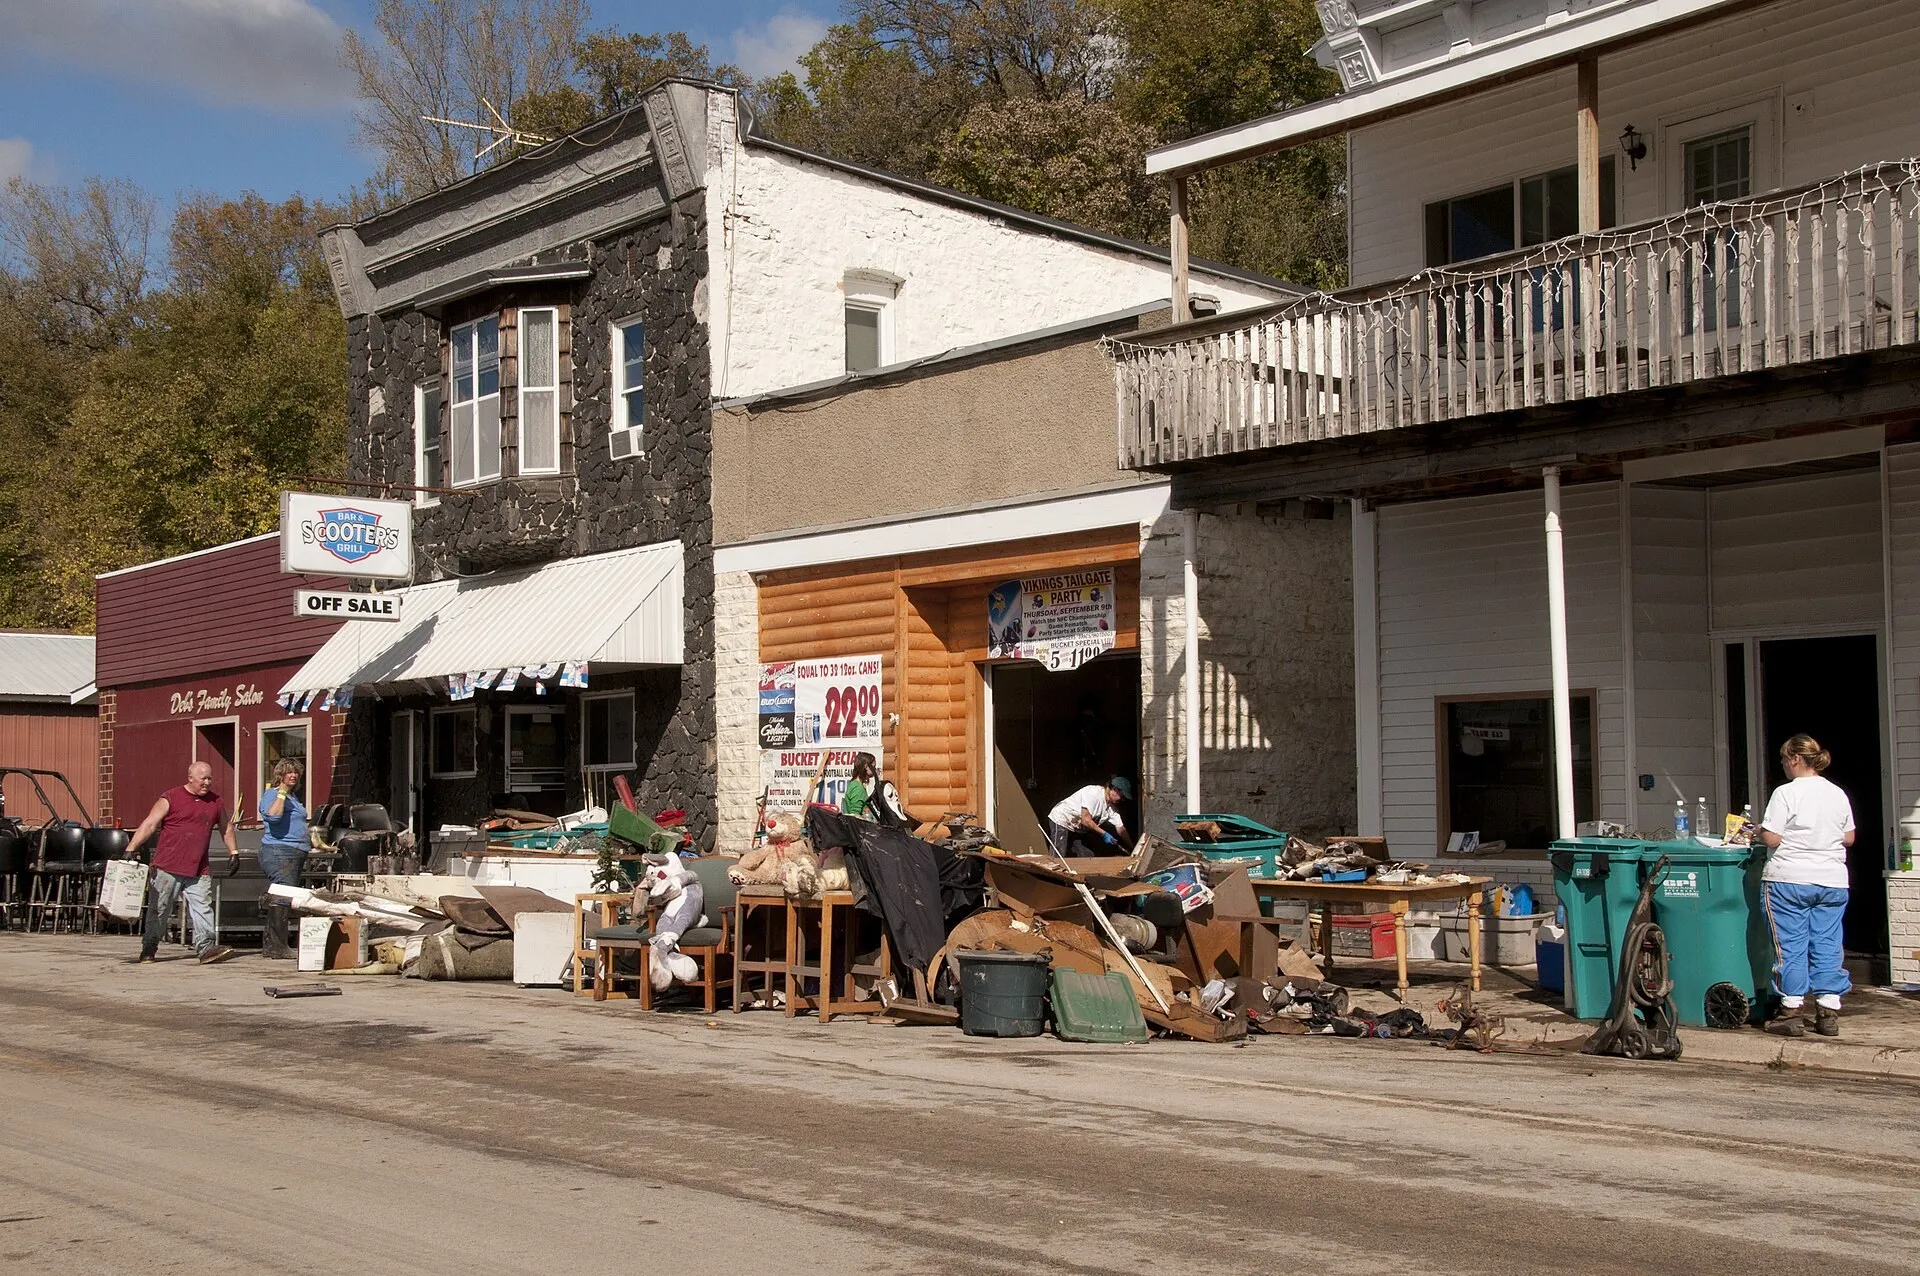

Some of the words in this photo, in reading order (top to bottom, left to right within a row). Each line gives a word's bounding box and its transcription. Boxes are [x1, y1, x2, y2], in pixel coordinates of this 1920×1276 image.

[337, 512, 356, 521] BAR
[301, 520, 399, 550] SCOOTER'S
[336, 543, 365, 553] GRILL
[1022, 576, 1063, 592] VIKINGS
[1064, 570, 1112, 586] TAILGATE
[1050, 589, 1082, 604] PARTY
[307, 596, 342, 612] OFF
[347, 598, 392, 614] SALE
[1023, 608, 1059, 618] THURSDAY,
[1060, 604, 1100, 615] SEPTEMBER
[1029, 617, 1046, 625] Watch
[1068, 613, 1107, 622] Championship
[1064, 620, 1088, 628] Rematch
[1038, 629, 1053, 637] Party
[1053, 627, 1069, 635] Starts
[1050, 639, 1074, 649] BUCKET
[1075, 637, 1102, 646] SPECIAL
[1050, 650, 1060, 669] 5
[797, 665, 818, 679] EQUAL
[819, 665, 828, 677] TO
[830, 664, 838, 677] 32
[858, 661, 879, 675] CANS!
[170, 690, 194, 715] Deb's
[196, 687, 231, 715] Family
[234, 683, 264, 707] Salon
[760, 697, 775, 706] BUD
[776, 696, 795, 705] LIGHT
[766, 734, 789, 742] LIGHT
[868, 728, 879, 737] CANS
[780, 752, 820, 766] BUCKET
[774, 769, 791, 778] DURING
[769, 788, 785, 796] BOTTLES
[119, 869, 145, 884] SYSCO
[302, 921, 329, 938] SYSCO
